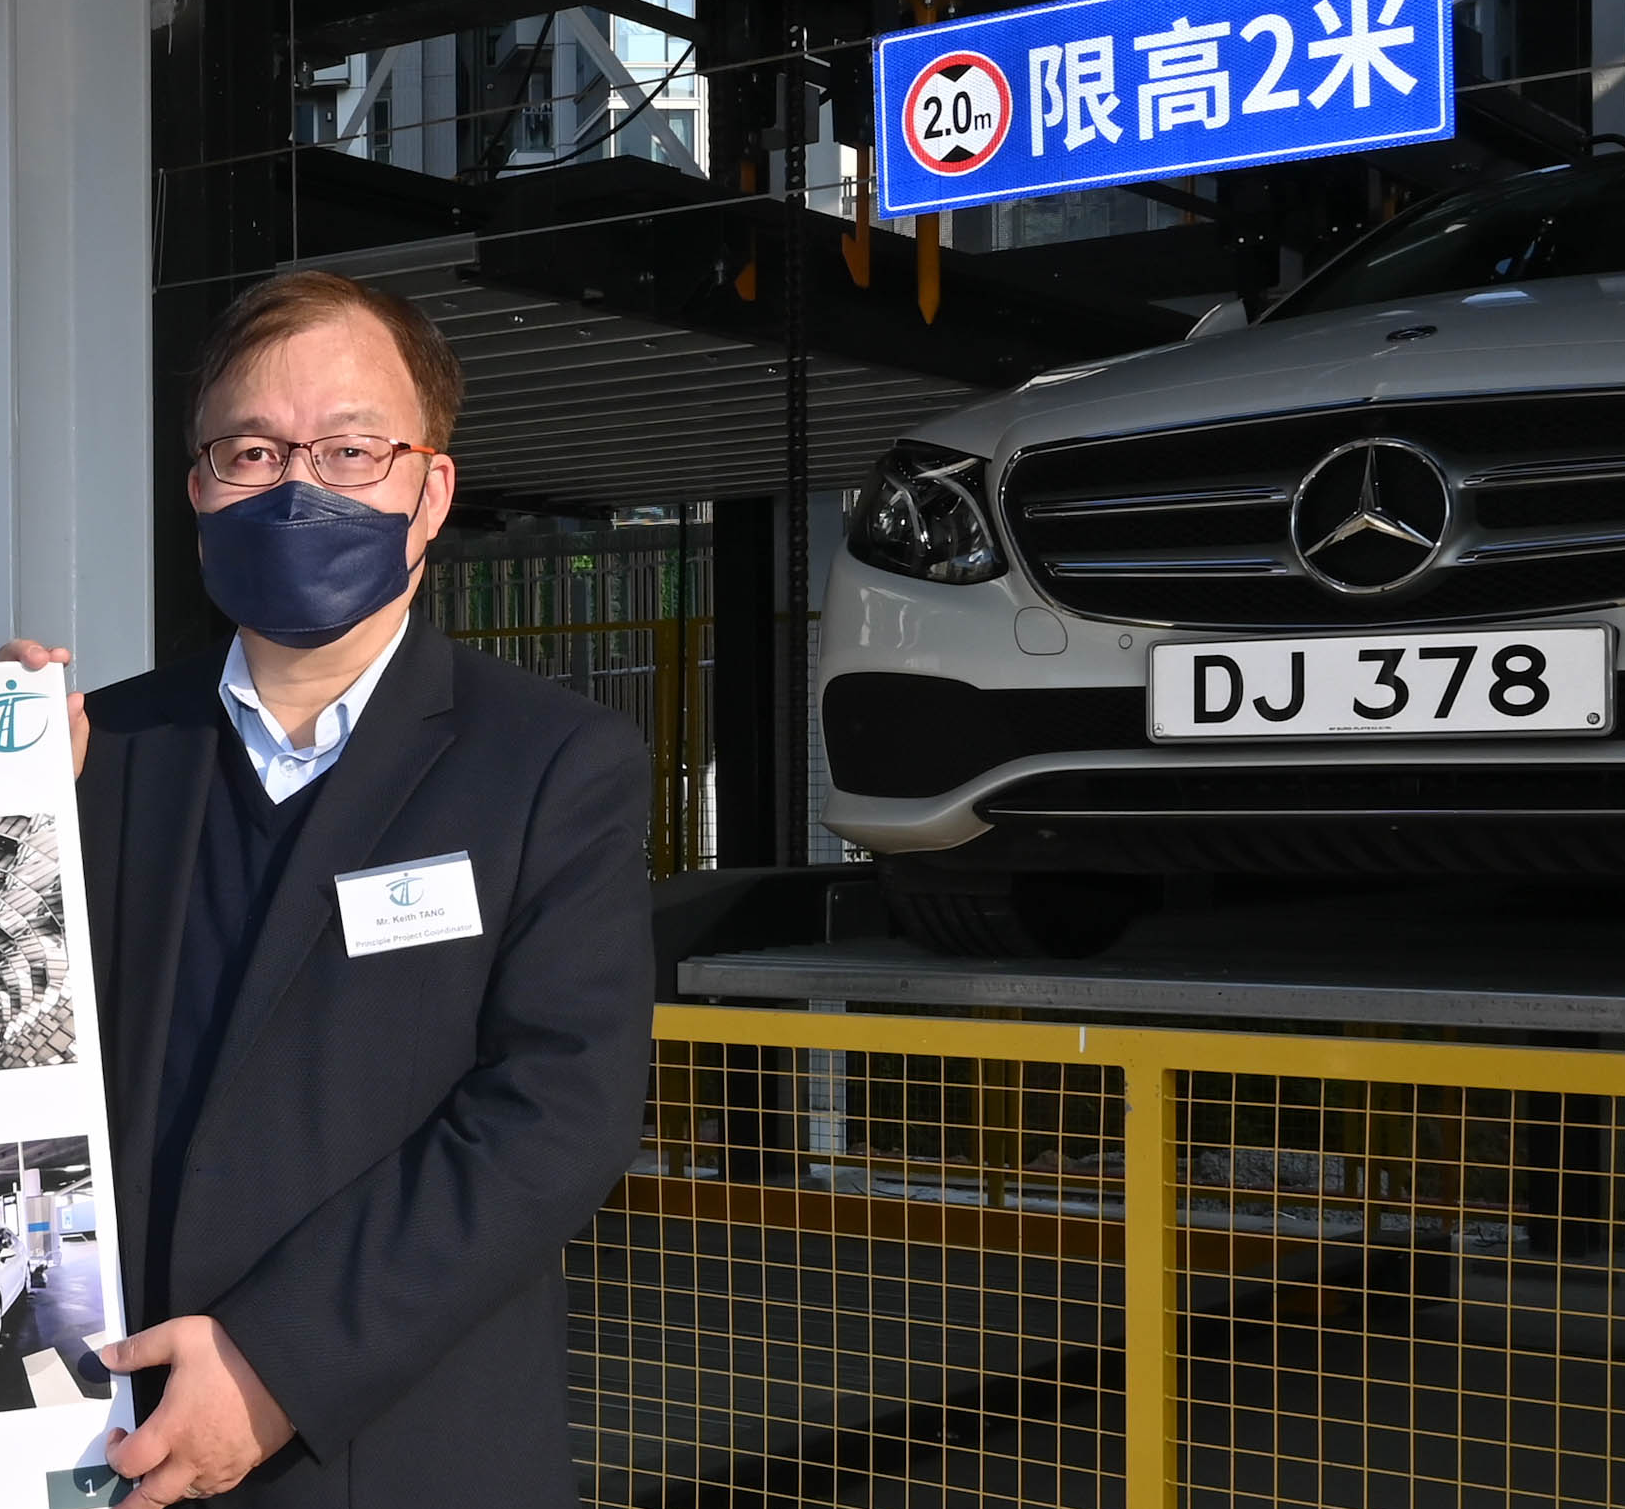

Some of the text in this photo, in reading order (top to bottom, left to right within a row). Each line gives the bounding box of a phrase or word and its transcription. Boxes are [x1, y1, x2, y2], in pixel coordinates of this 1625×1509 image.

[922, 90, 992, 141] 2.0m
[1193, 643, 1550, 724] DJ 378
[392, 912, 417, 924] Keith
[419, 908, 445, 919] TANG
[393, 931, 422, 943] Project
[84, 1478, 97, 1497] 1
